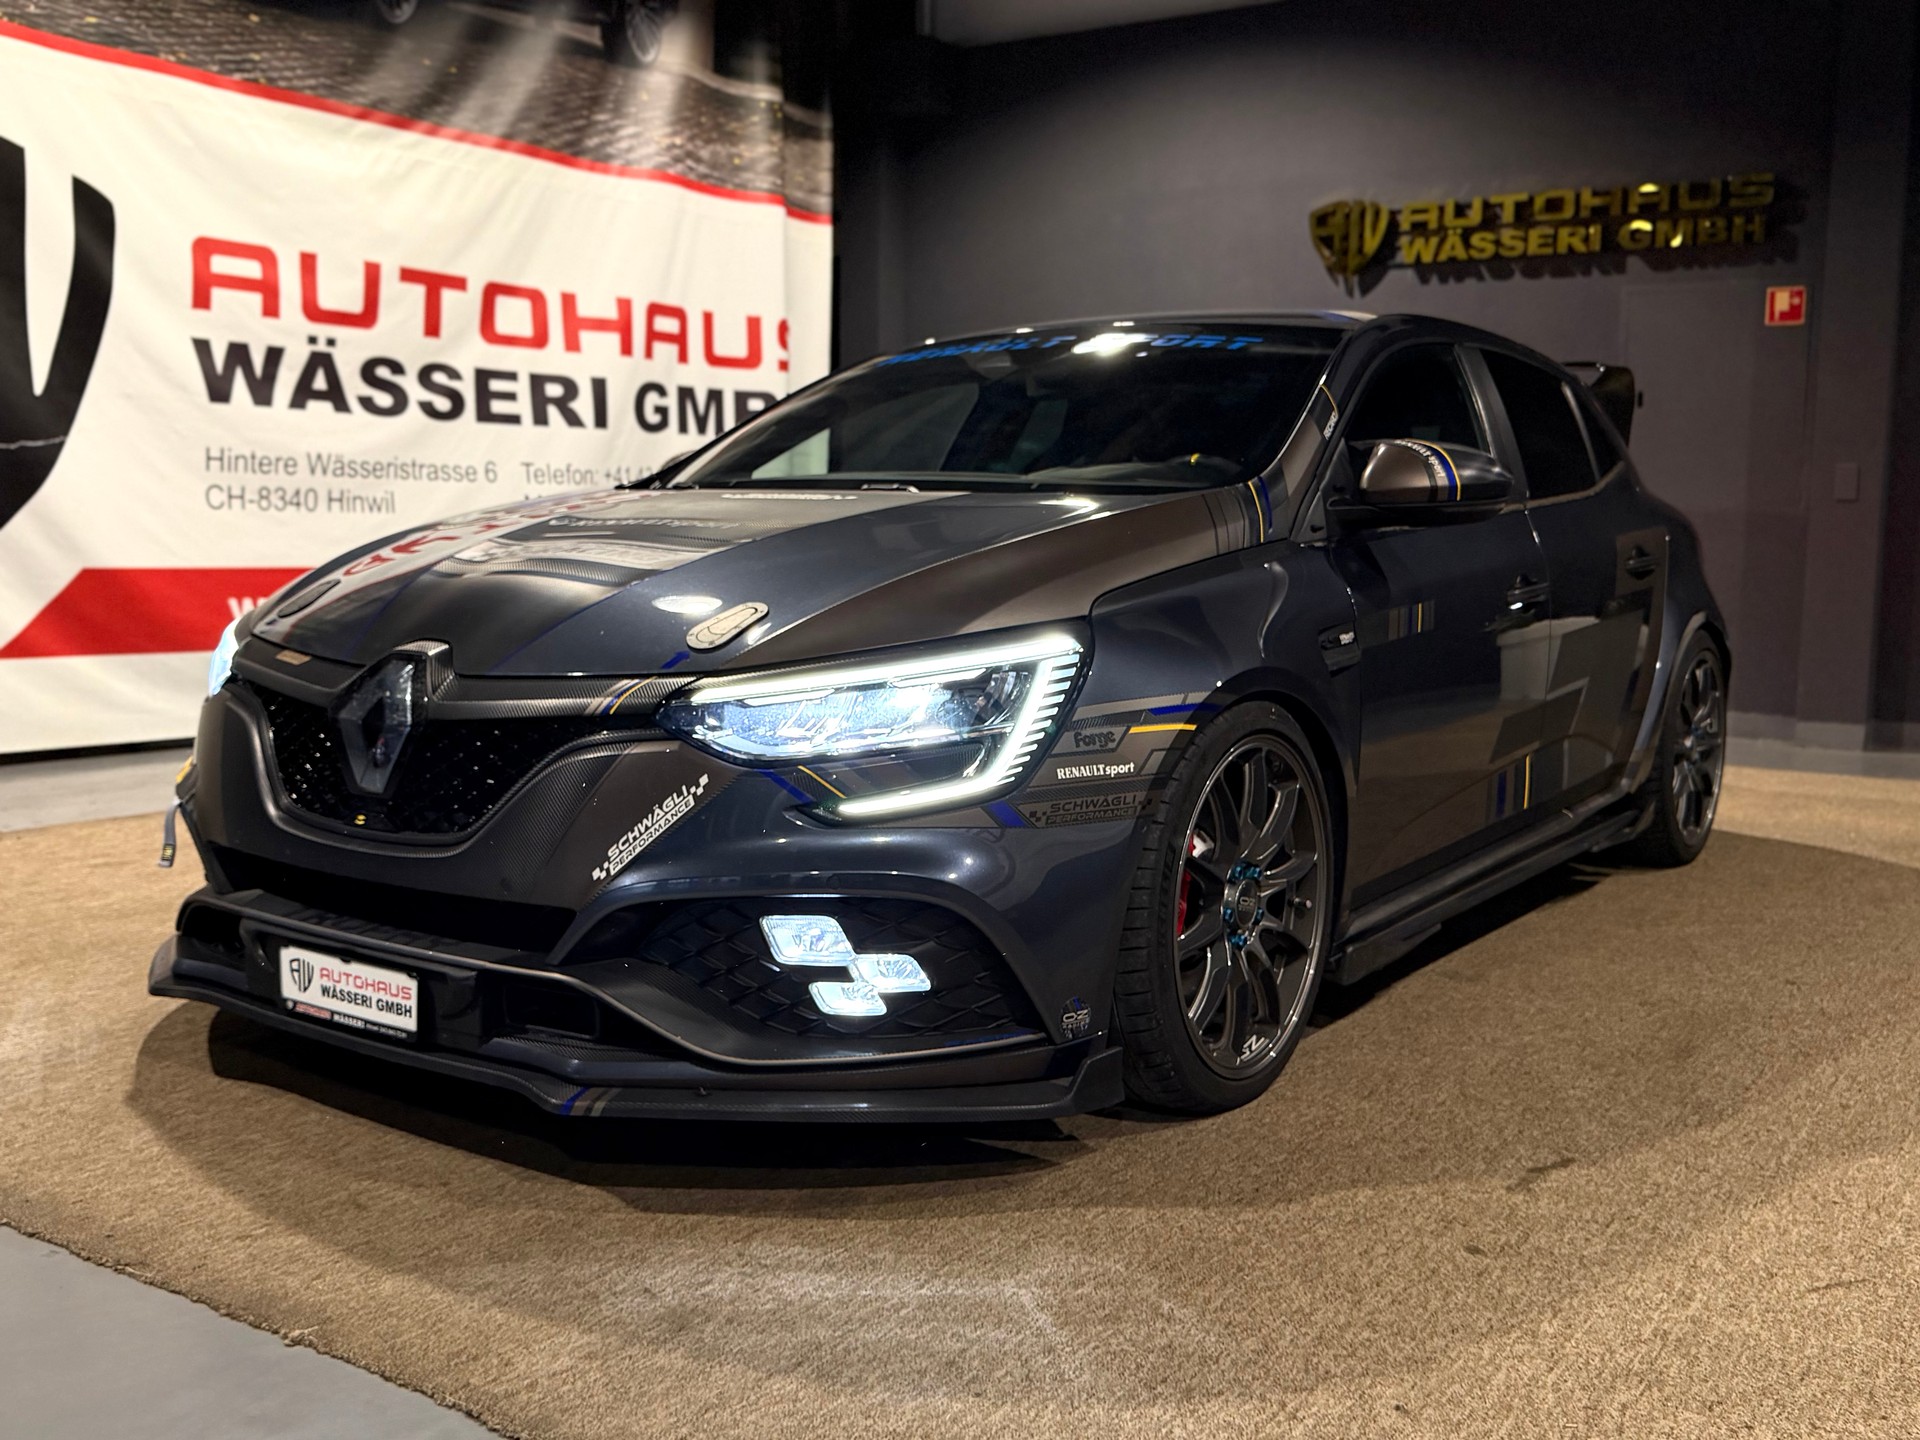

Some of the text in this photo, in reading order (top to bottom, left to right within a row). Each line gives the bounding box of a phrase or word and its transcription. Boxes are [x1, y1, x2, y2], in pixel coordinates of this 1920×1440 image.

[1400, 172, 1775, 231] AUTOHAUS
[1402, 212, 1767, 265] WÄSSERI GMBH
[191, 235, 790, 372] AUTOHAU
[190, 333, 790, 437] WÄSSERI GMB
[204, 447, 498, 483] Hintere Wässeristrasse 6
[520, 461, 600, 486] Telefon:
[204, 484, 397, 514] CH-8340 Hinwil
[607, 784, 689, 859] SCHWÄGLI
[1047, 806, 1136, 824] PERFORMANCE
[611, 797, 695, 874] PERFORMANCE
[320, 967, 412, 1000] AUTOHAUS
[376, 998, 413, 1018] GMBH
[1062, 1009, 1089, 1022] OZ
